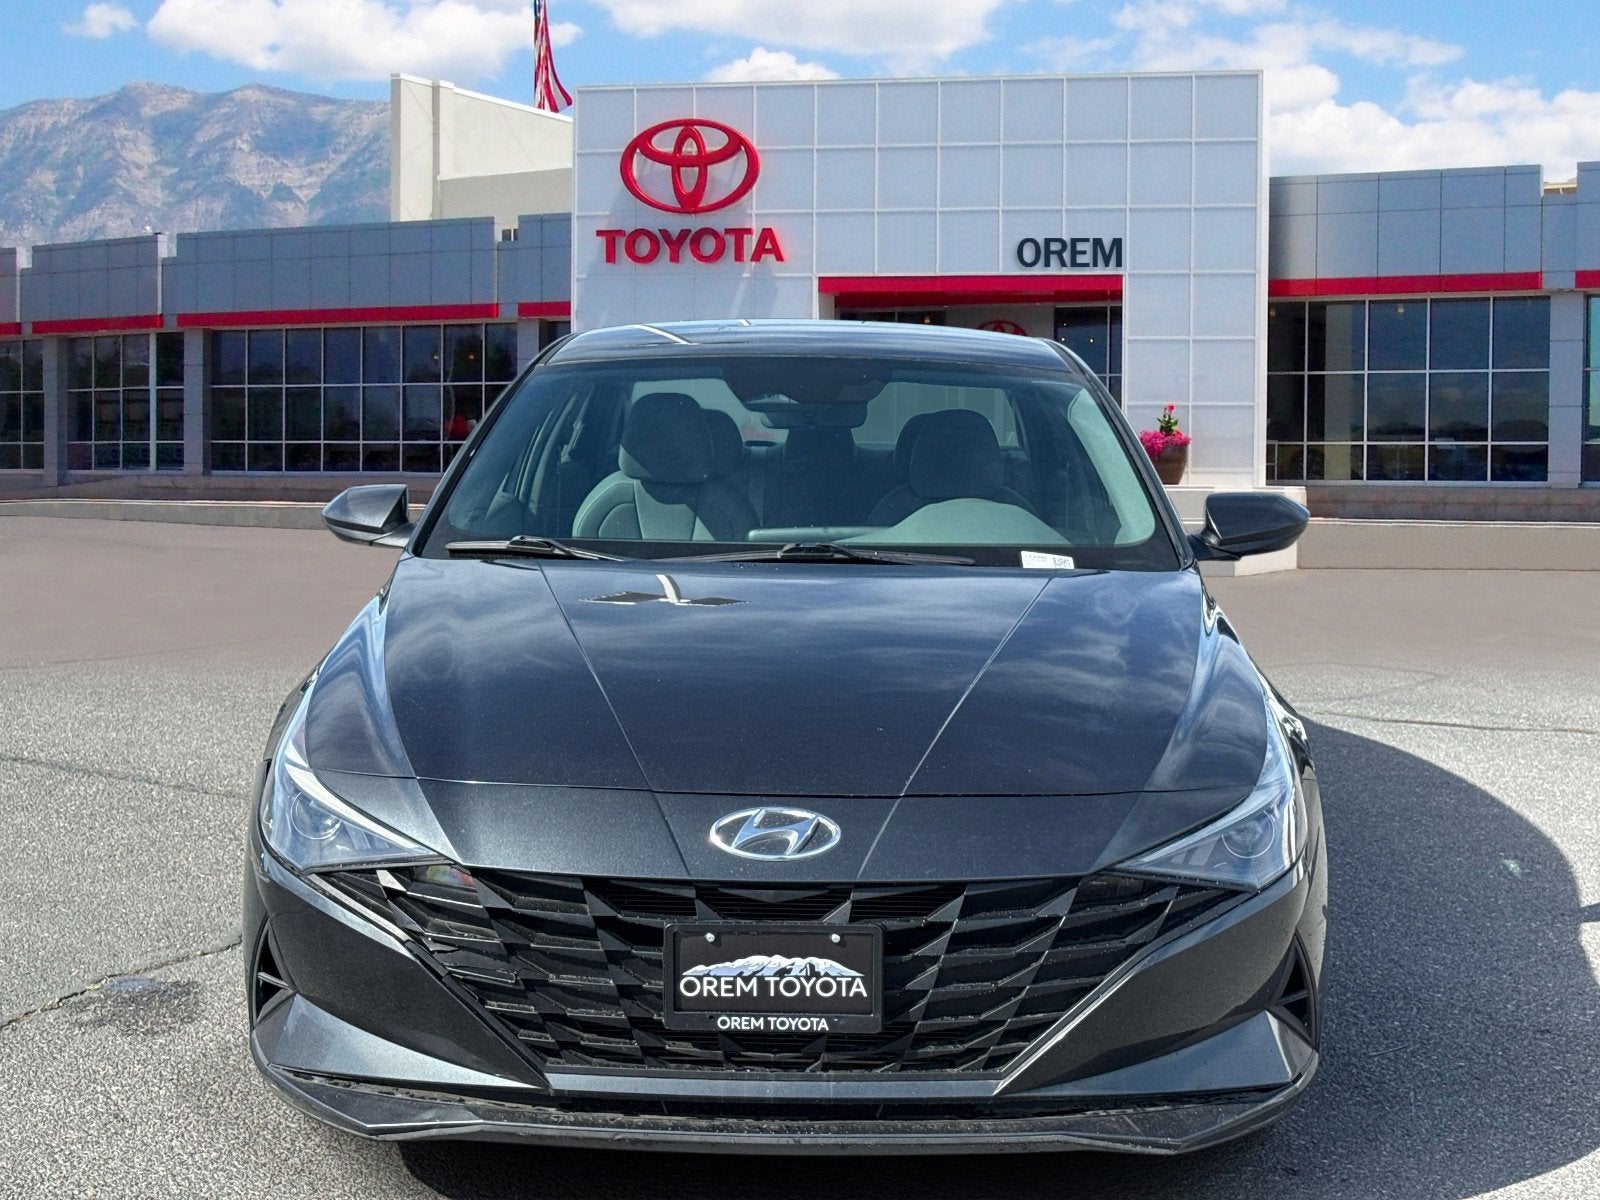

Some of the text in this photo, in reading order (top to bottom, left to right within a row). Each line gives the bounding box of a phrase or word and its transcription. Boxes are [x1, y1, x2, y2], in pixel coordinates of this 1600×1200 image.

[596, 226, 786, 264] TOYOTA
[1016, 237, 1123, 268] OREM
[679, 976, 868, 998] OREM TOYOTA
[717, 1016, 829, 1031] OREM TOYOTA
